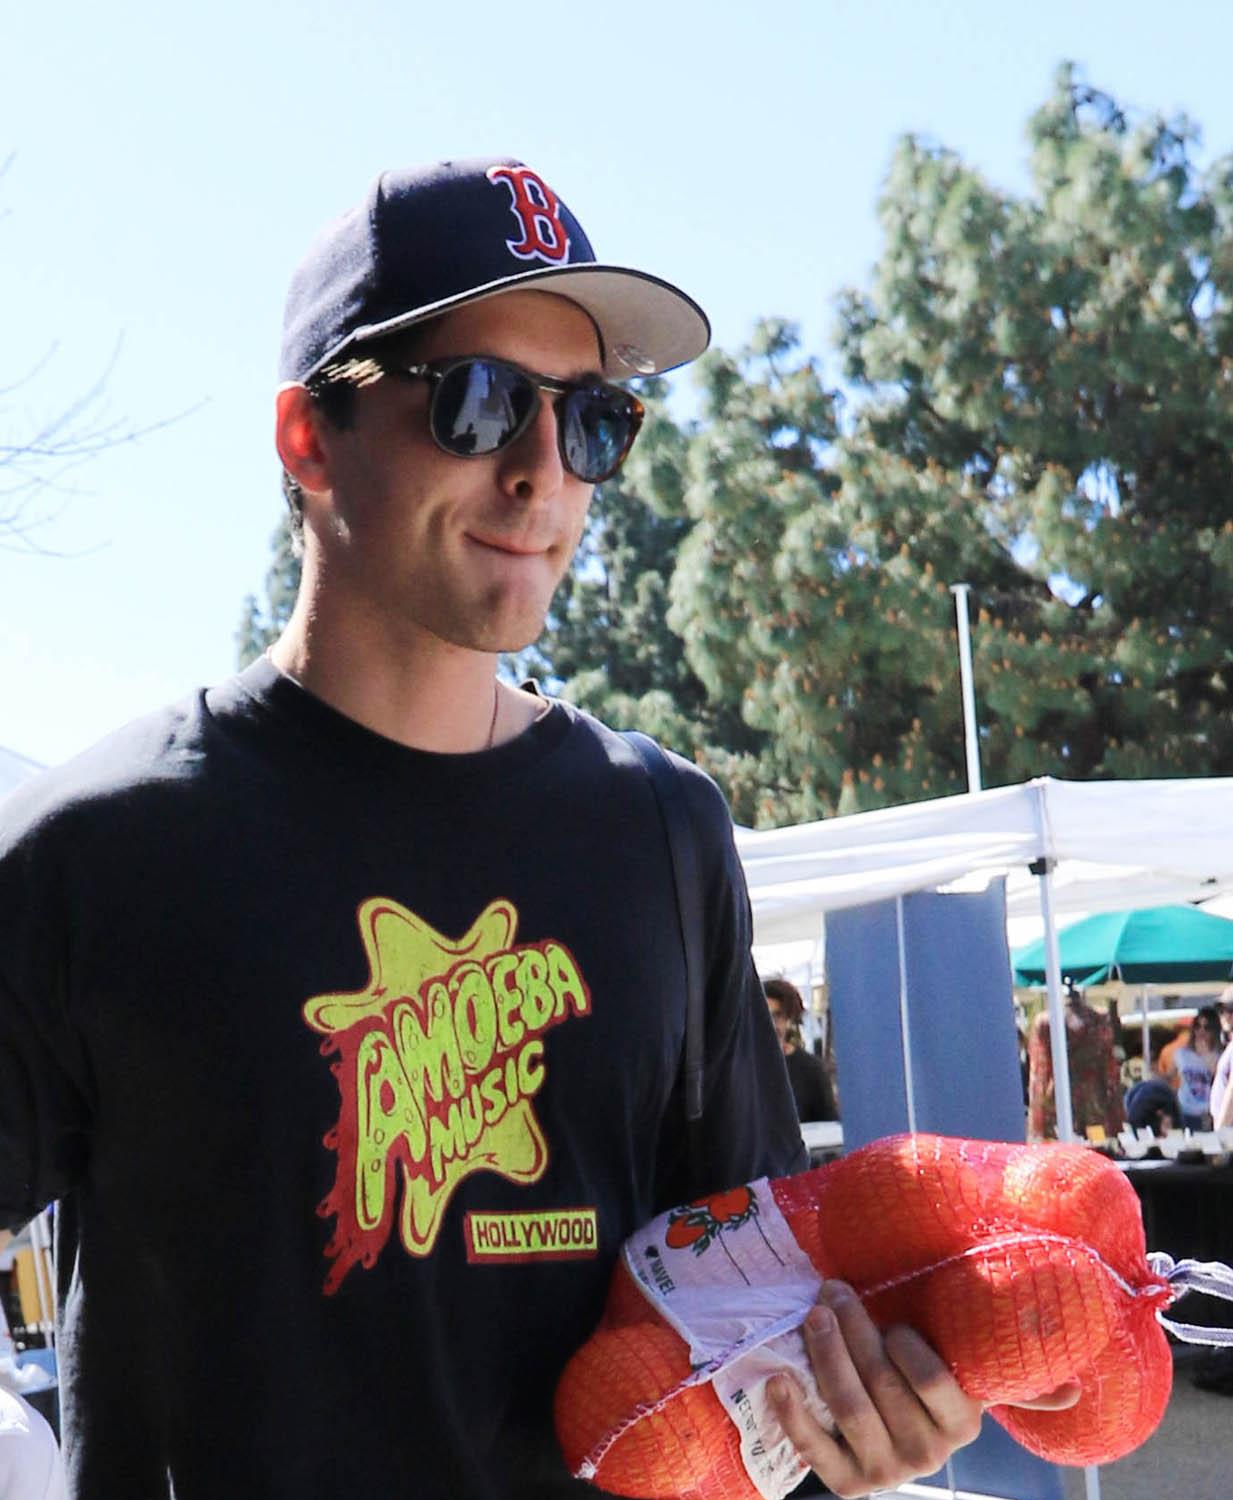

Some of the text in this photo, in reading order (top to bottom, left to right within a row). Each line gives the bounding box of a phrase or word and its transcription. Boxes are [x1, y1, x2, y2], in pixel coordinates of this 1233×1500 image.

[486, 166, 571, 265] B
[356, 943, 588, 1231] AMOEBA
[429, 1040, 545, 1183] MUSIC
[475, 1217, 595, 1248] HOLLYWOOD
[651, 1259, 676, 1296] NAVEL
